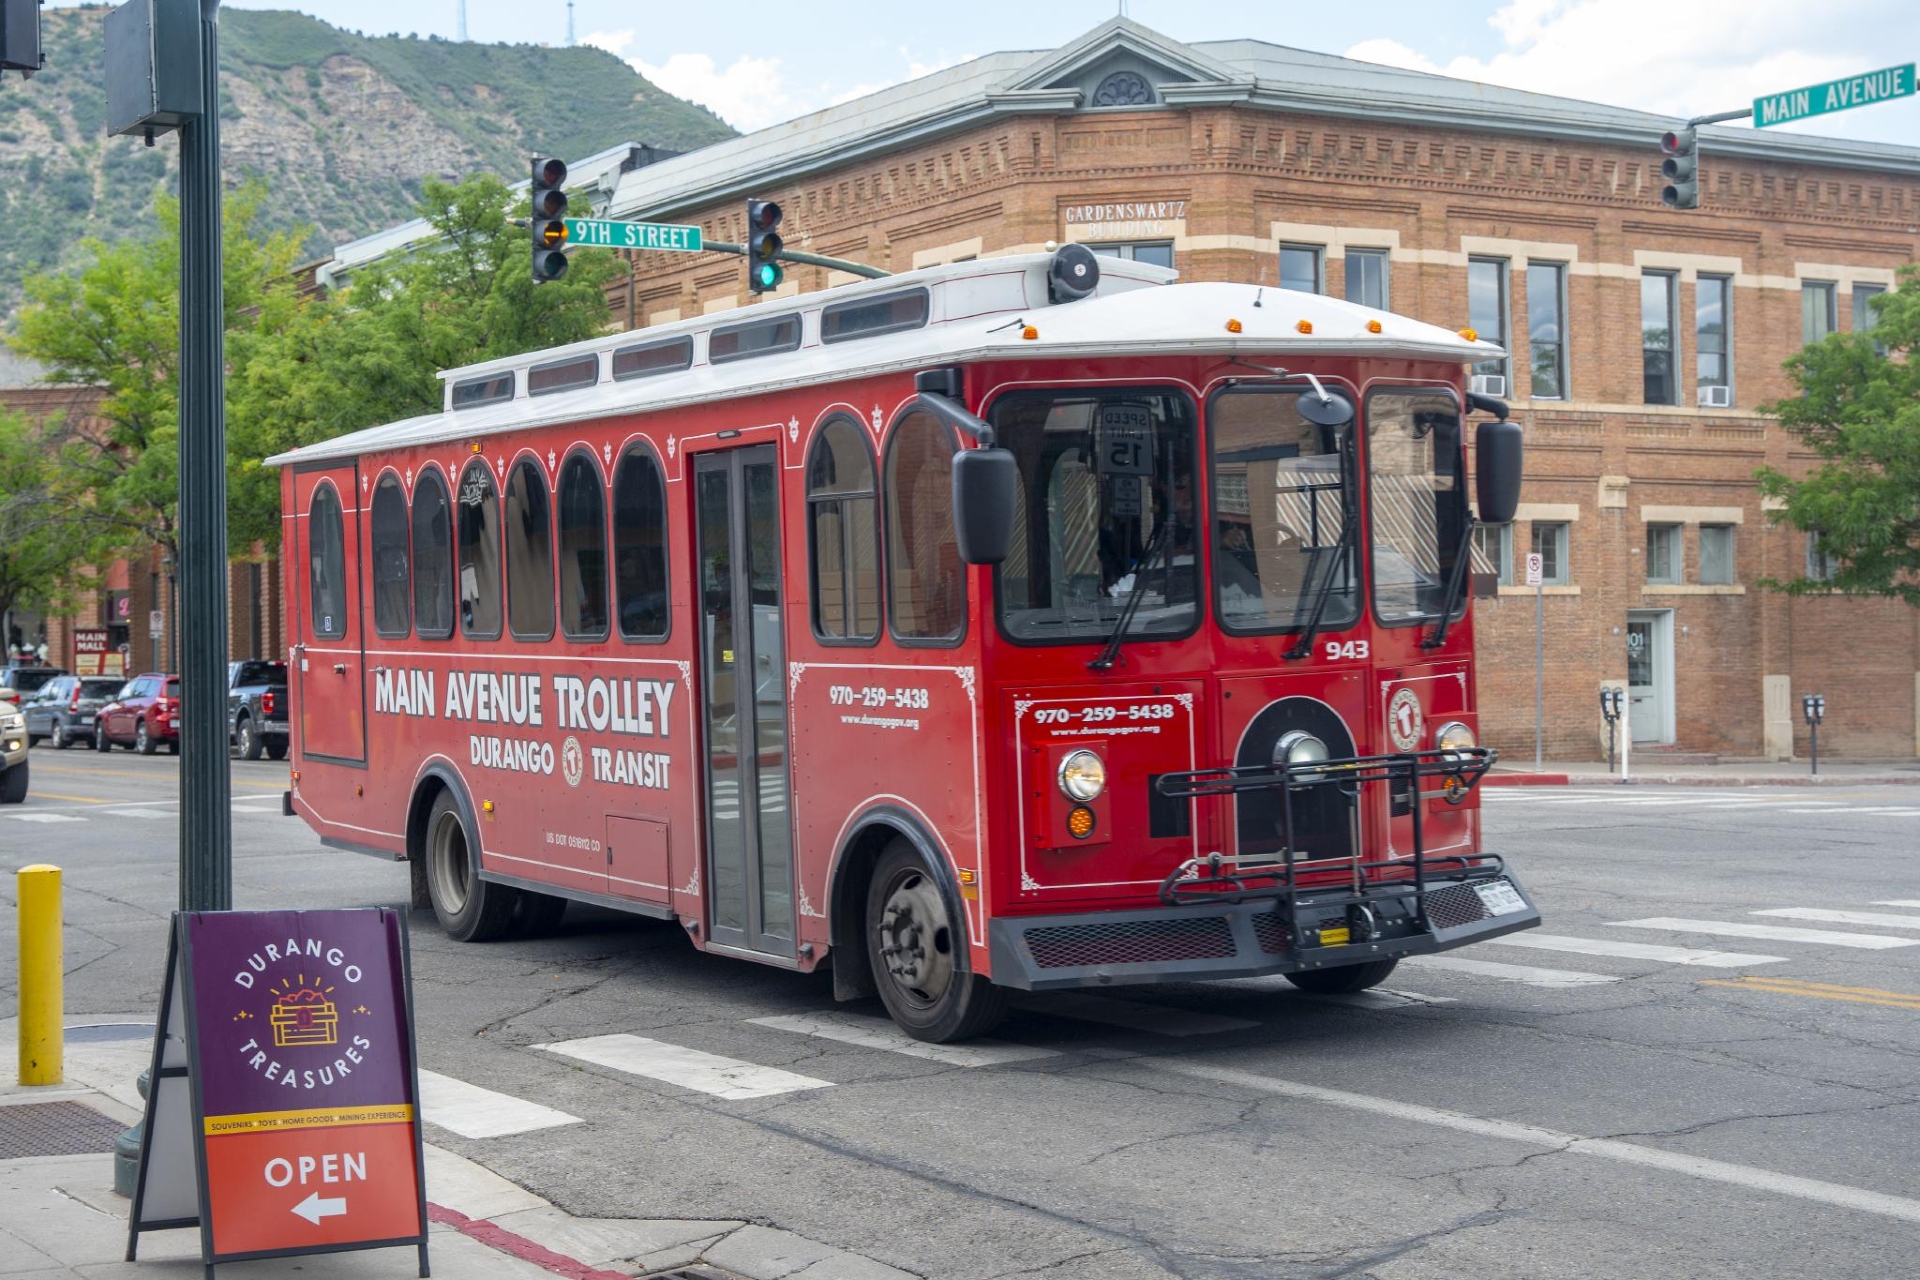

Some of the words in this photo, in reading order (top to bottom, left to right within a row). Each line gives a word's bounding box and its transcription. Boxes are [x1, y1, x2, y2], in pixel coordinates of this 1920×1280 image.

[1762, 89, 1809, 124] MAIN
[1825, 69, 1905, 110] AVENUE
[1066, 201, 1185, 222] GARDENSWARTZ
[576, 221, 611, 244] 9TH
[625, 224, 690, 248] STREET
[1088, 219, 1163, 237] BUILDING
[75, 632, 107, 642] MAIN
[76, 642, 106, 651] MALL
[1325, 640, 1370, 661] 943
[375, 669, 435, 717] MAIN
[445, 671, 543, 725] AVENUE
[553, 676, 676, 737] TROLLEY
[829, 685, 929, 709] 970-259-5438
[840, 713, 920, 731] www.durangogov.org
[1034, 704, 1174, 724] 970-259-5438
[1050, 725, 1161, 736] www.durangogov.org
[470, 735, 555, 775] DURANGO
[591, 747, 671, 790] TRANSIT
[546, 832, 555, 844] US
[556, 834, 567, 846] DOT
[234, 938, 362, 989] DURANGO
[240, 1034, 370, 1089] TREASURES
[211, 1121, 253, 1131] SOUVENIRS
[258, 1119, 277, 1127] TOYS
[283, 1116, 305, 1125] HOME
[306, 1115, 334, 1124] GOODS
[339, 1112, 366, 1122] MINING
[367, 1110, 406, 1121] EXPERIENCE
[264, 1152, 367, 1188] OPEN
